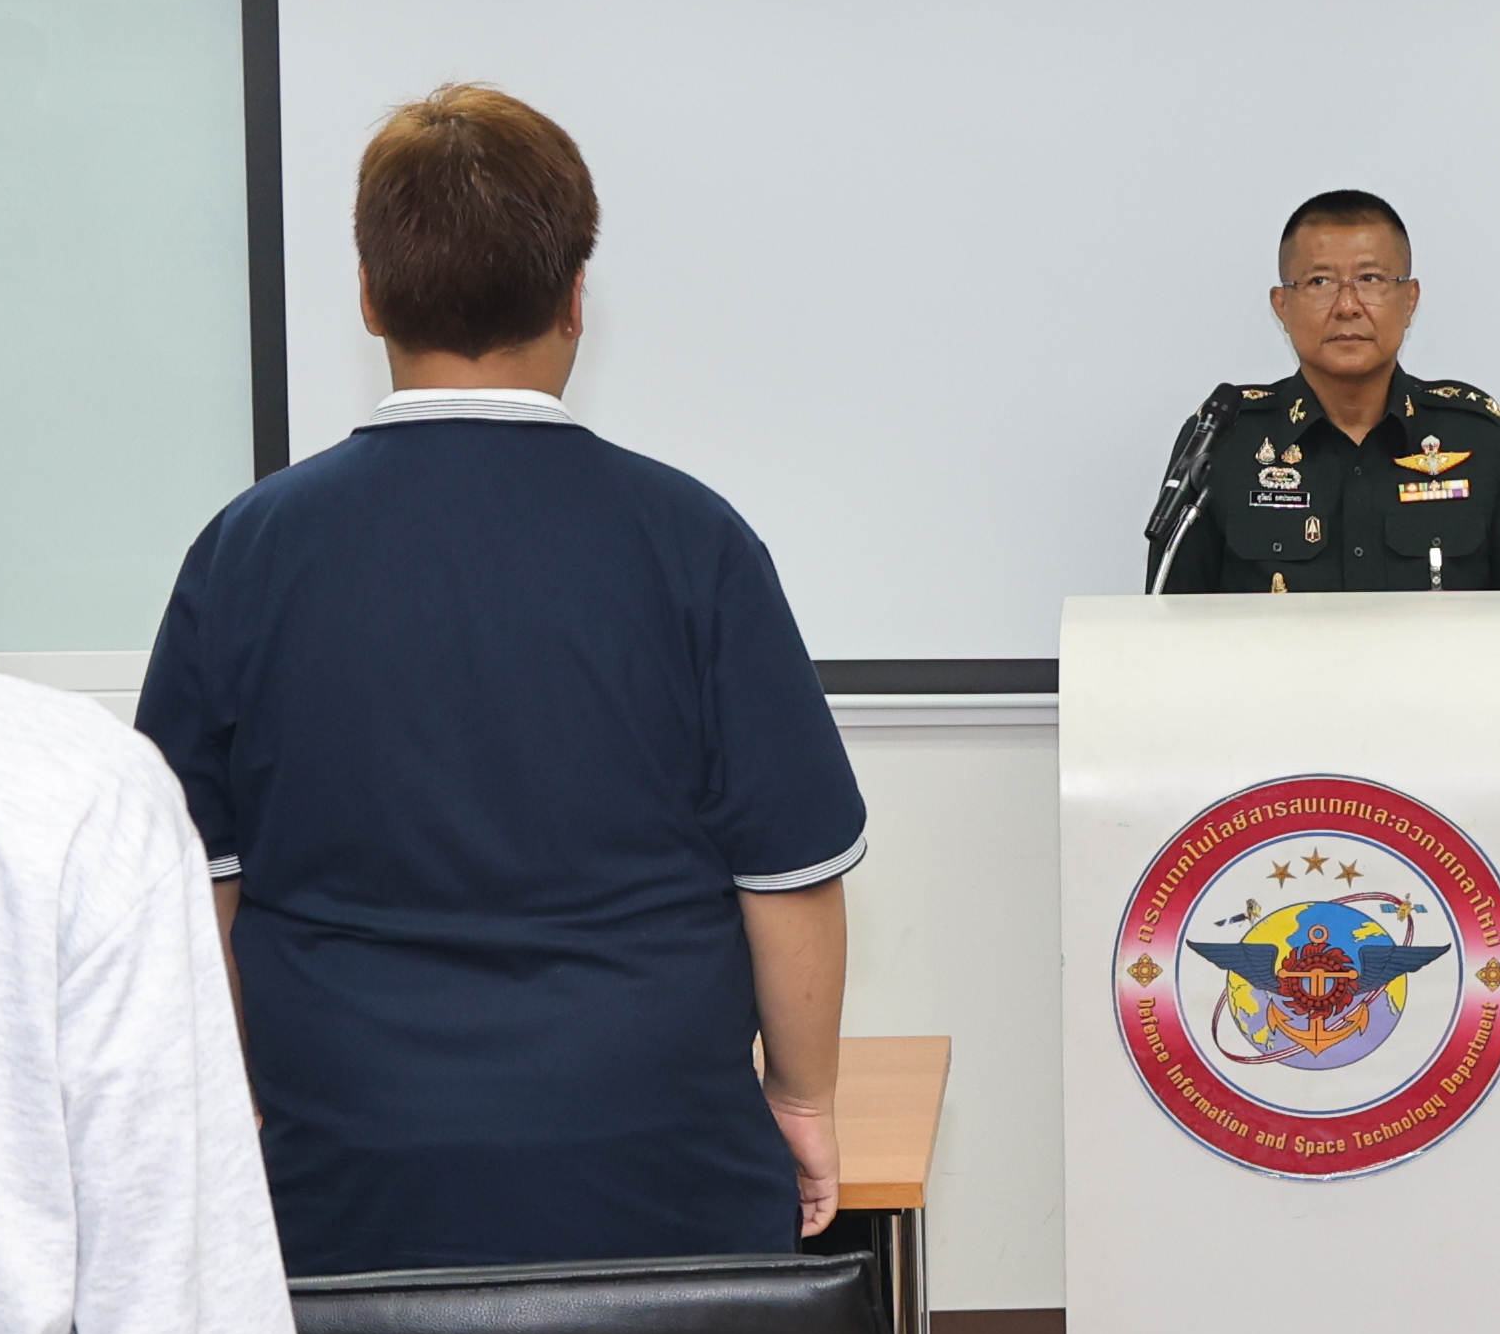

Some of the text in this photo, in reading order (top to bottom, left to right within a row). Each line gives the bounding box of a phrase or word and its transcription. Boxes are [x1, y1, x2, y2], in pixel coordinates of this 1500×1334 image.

[1136, 996, 1499, 1156] Defence Information and Space Technology Department
